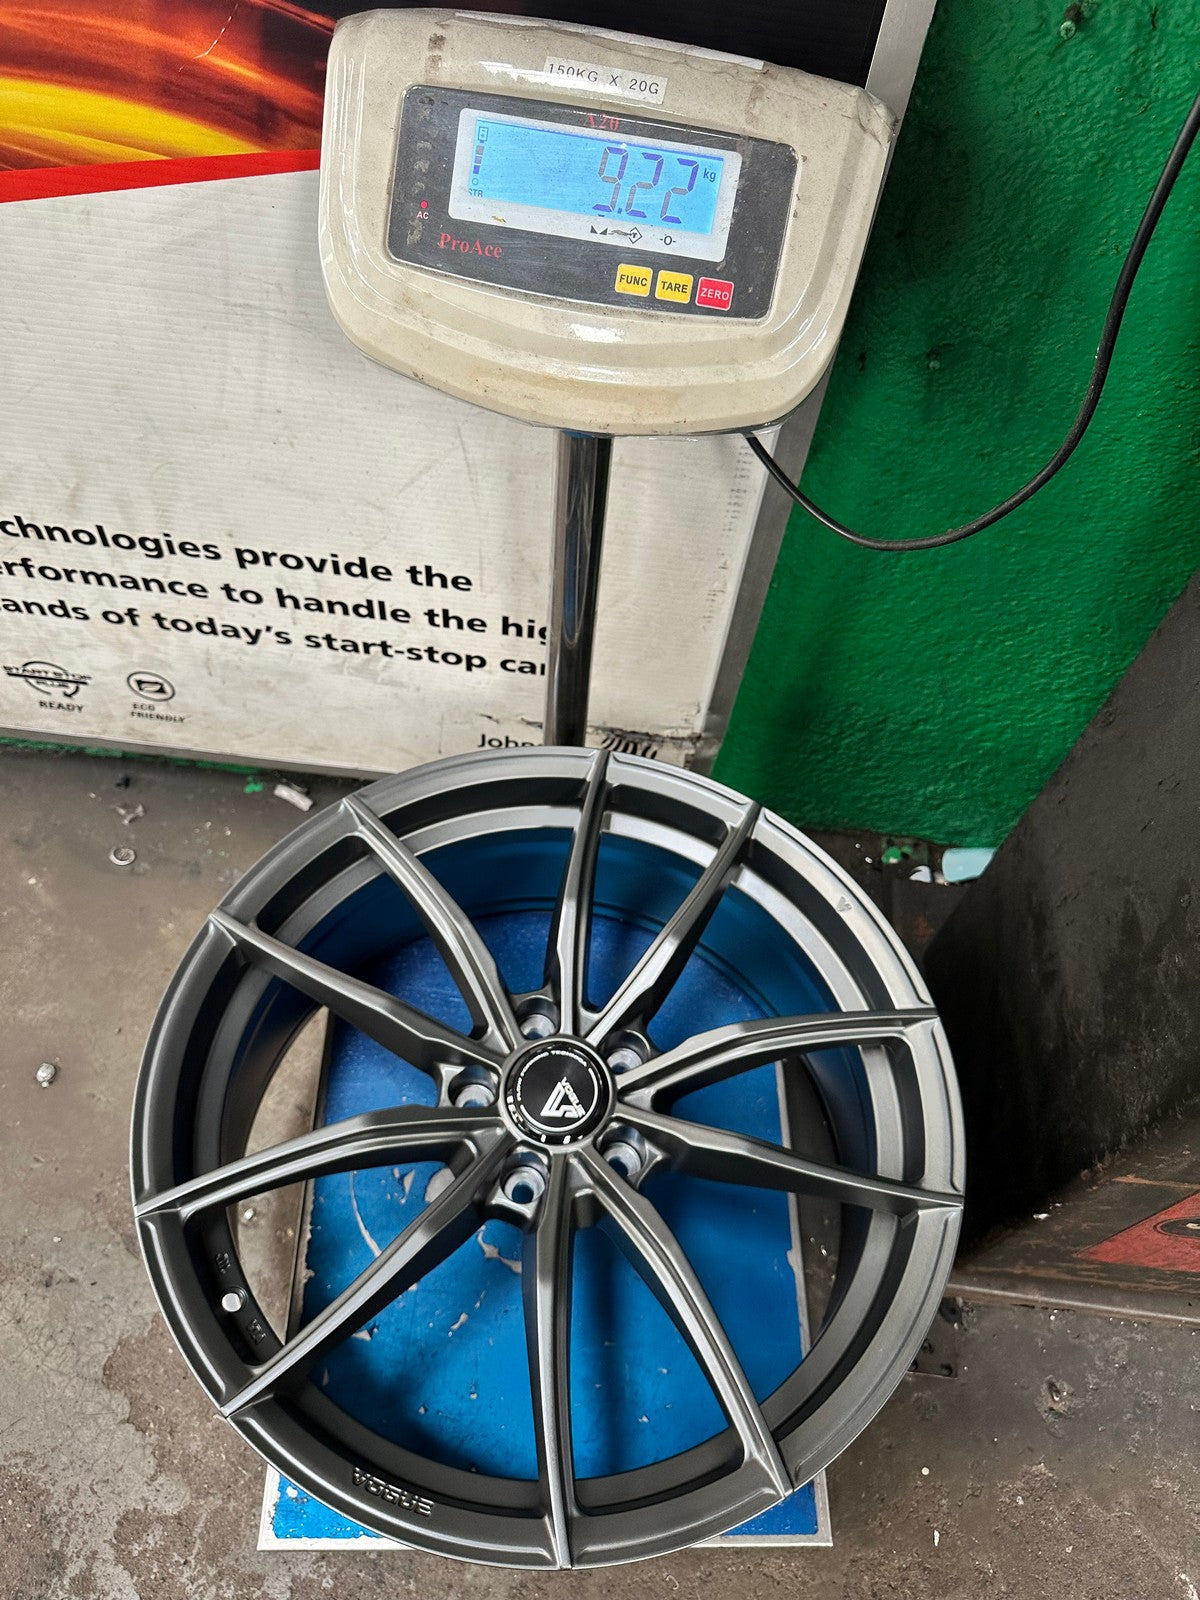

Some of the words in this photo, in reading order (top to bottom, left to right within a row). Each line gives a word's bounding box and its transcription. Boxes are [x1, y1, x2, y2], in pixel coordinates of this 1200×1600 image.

[549, 63, 599, 83] 150KG
[609, 75, 619, 86] X
[629, 78, 660, 95] 20G
[703, 167, 717, 182] kg
[416, 211, 430, 220] AC
[438, 232, 503, 258] ProAce
[619, 274, 648, 287] FUNC
[661, 281, 688, 294] TARE
[700, 287, 730, 301] ZERO
[234, 547, 393, 582] provide
[405, 565, 473, 592] the
[0, 557, 208, 599] rformance
[220, 583, 264, 605] to
[275, 587, 411, 624] handle
[423, 608, 488, 633] the
[102, 607, 140, 627] of
[152, 612, 293, 646] today's
[304, 633, 487, 672] start-stop
[353, 1467, 435, 1517] VOGUE
